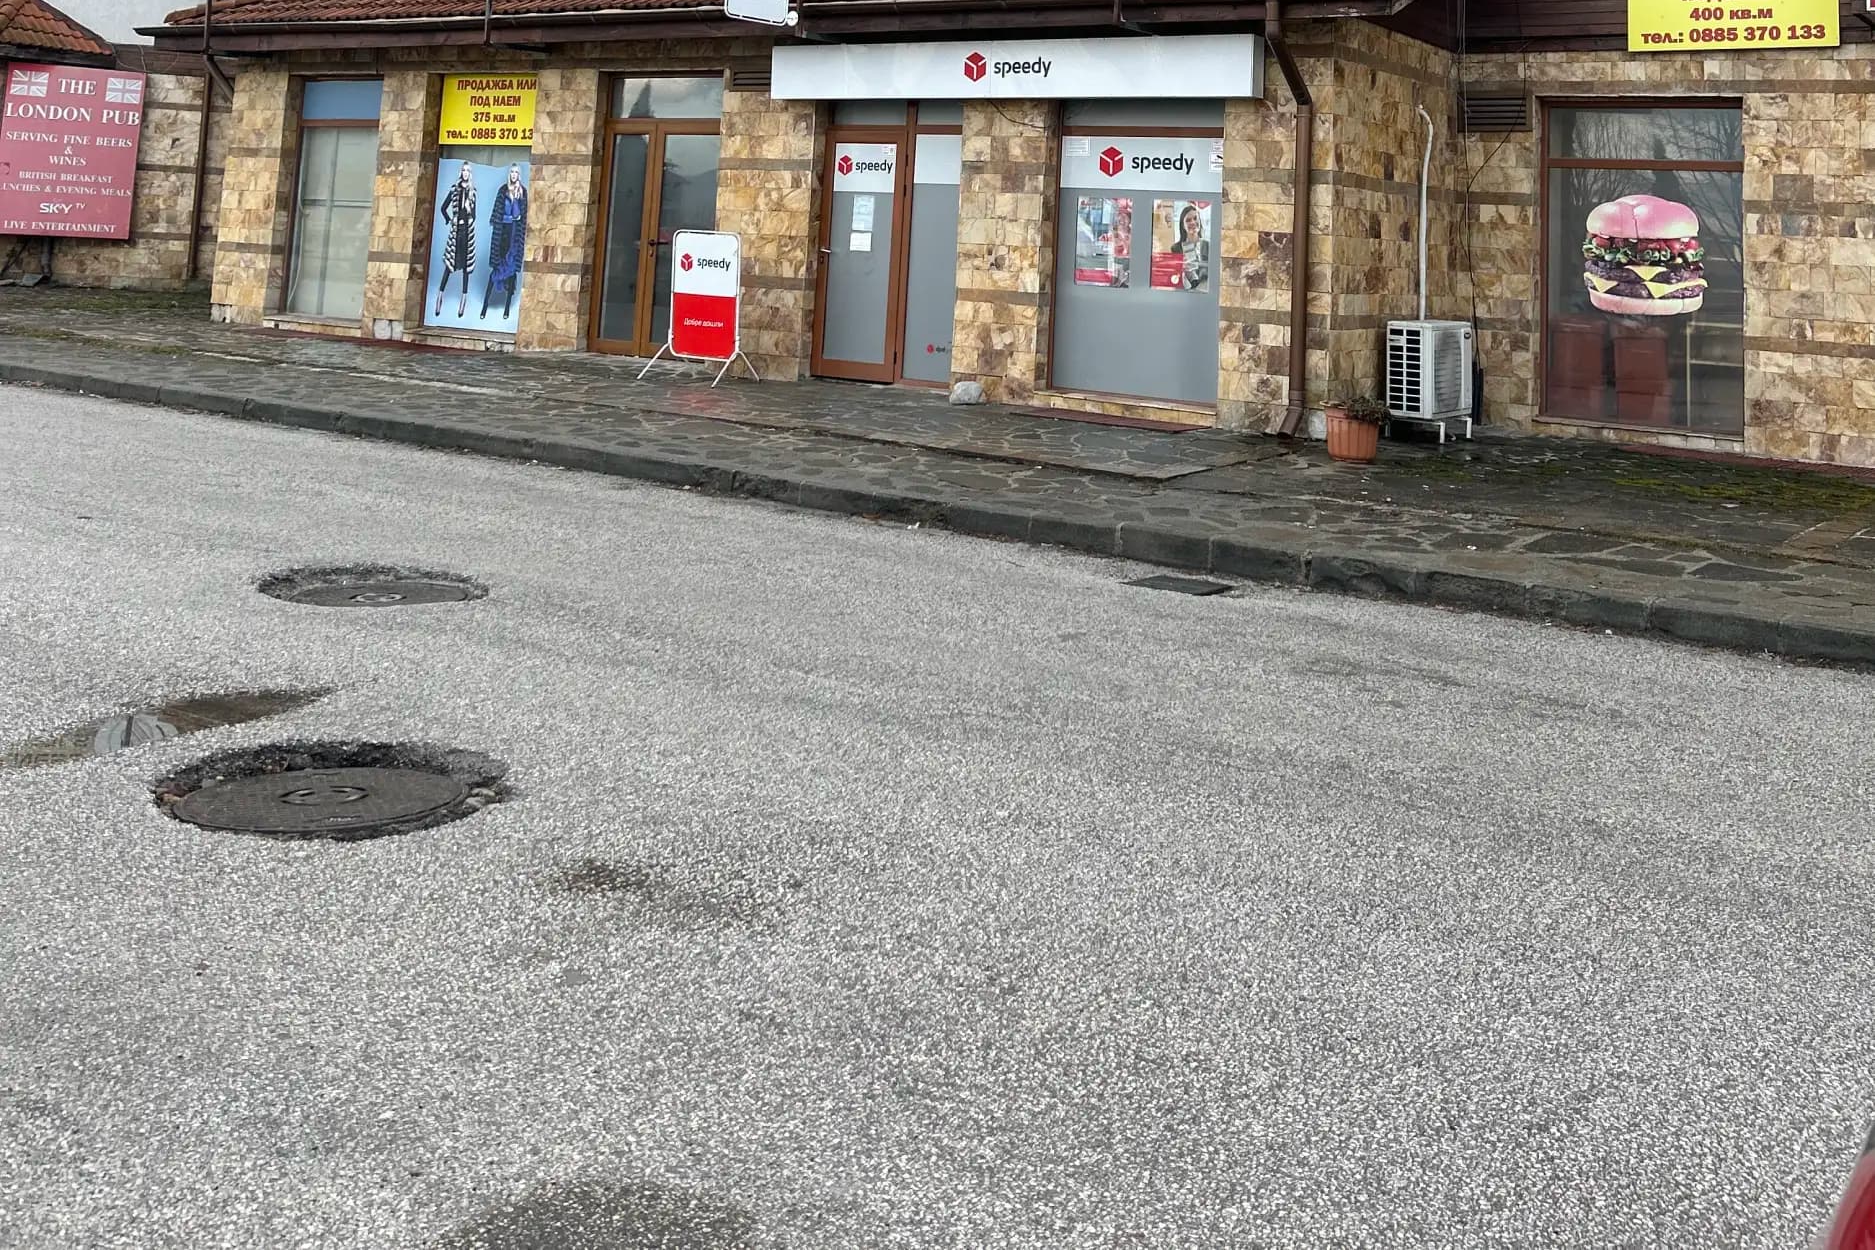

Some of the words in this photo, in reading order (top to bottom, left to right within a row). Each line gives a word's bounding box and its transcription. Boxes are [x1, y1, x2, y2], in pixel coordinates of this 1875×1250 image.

[1689, 7, 1724, 21] 400
[1730, 7, 1773, 20] кв.м
[1641, 31, 1684, 44] тел.:
[1689, 27, 1738, 43] 0885
[1744, 26, 1781, 40] 370
[1787, 24, 1826, 39] 133
[993, 56, 1052, 78] speedy
[58, 78, 97, 95] THE
[457, 79, 514, 92] ПРОДАЖБА
[516, 79, 537, 90] ИЛИ
[470, 95, 491, 108] ПОД
[492, 95, 521, 106] НАЕМ
[6, 102, 92, 122] LONDON
[101, 109, 139, 126] PUB
[472, 112, 490, 122] 375
[6, 131, 58, 143] SERVING
[63, 134, 91, 145] FINE
[96, 136, 133, 148] BEERS
[471, 128, 496, 139] 0885
[499, 128, 518, 139] 370
[64, 145, 73, 155] &
[49, 155, 87, 166] WINES
[855, 159, 893, 174] speedy
[1132, 153, 1194, 175] speedy
[19, 171, 56, 180] BRITISH
[61, 173, 113, 183] BREAKFAST
[44, 185, 52, 193] &
[56, 185, 97, 195] EVENING
[101, 188, 132, 197] MEALS
[39, 202, 72, 214] SKY
[4, 220, 28, 229] LIVE
[31, 221, 117, 233] ENTERTAINMENT
[697, 257, 731, 272] speedy
